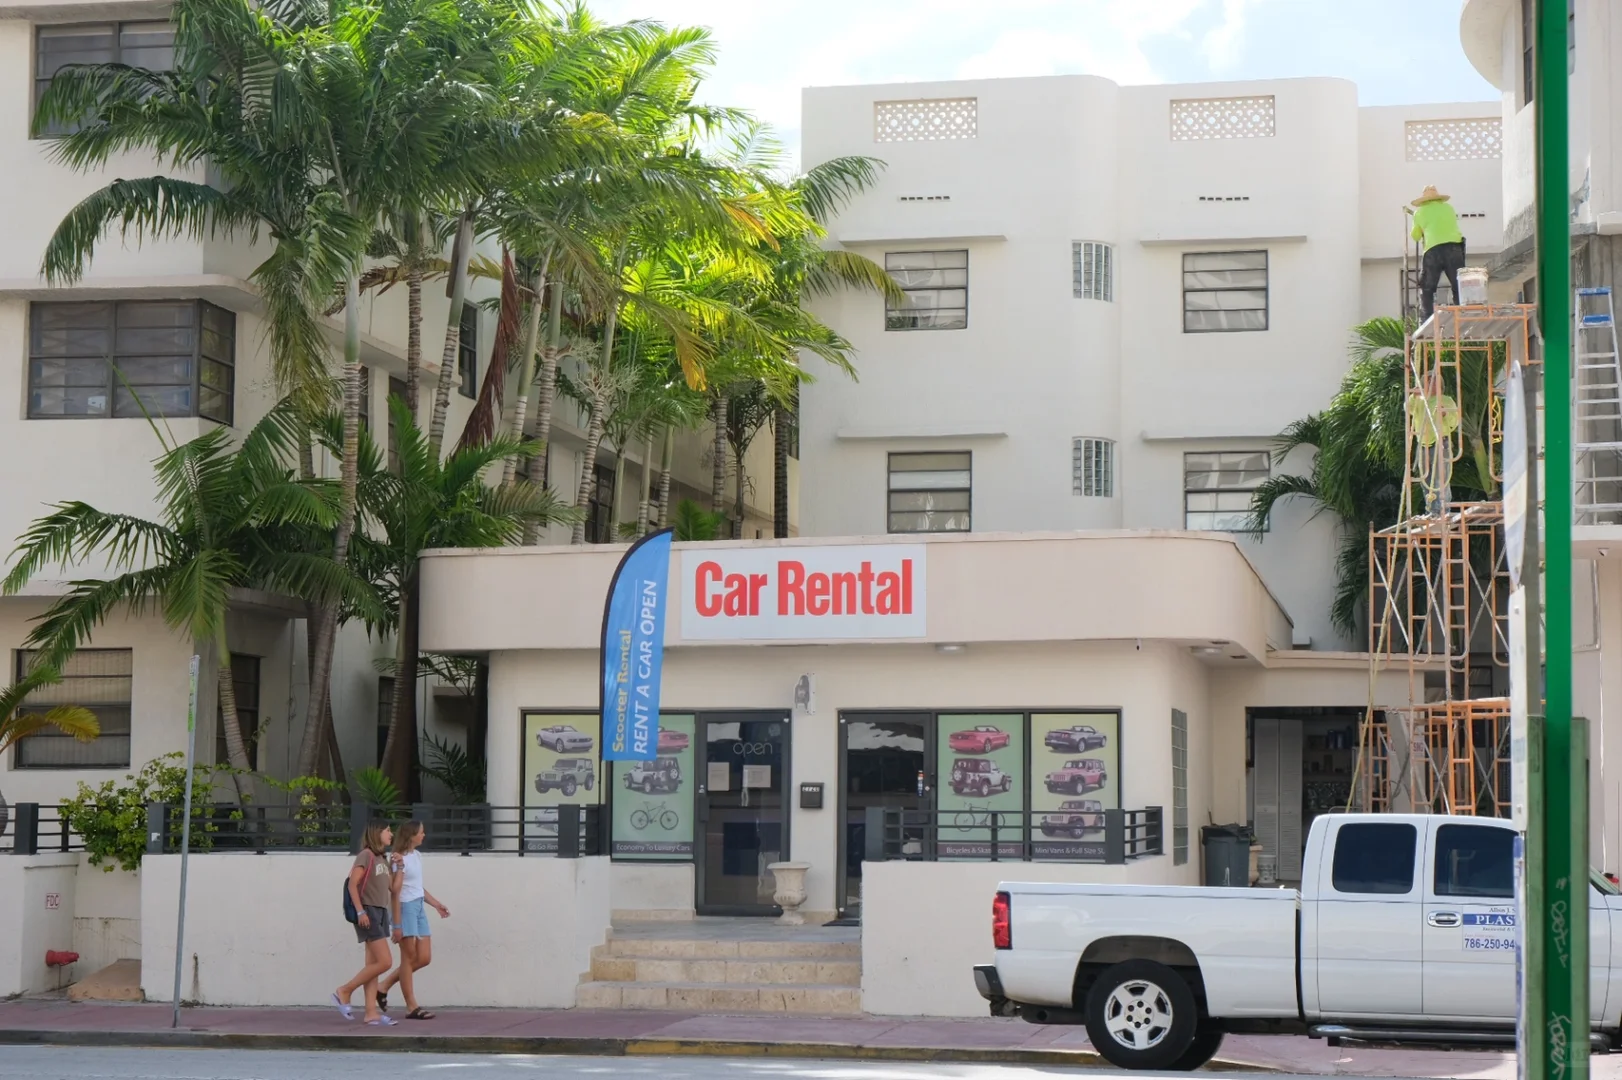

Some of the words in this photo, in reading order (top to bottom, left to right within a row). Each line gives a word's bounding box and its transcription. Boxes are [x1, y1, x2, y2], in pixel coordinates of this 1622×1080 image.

[695, 560, 767, 617] Car
[777, 559, 912, 616] Rental
[640, 580, 657, 635] OPEN
[617, 629, 631, 683] Rental
[638, 640, 653, 680] CAR
[636, 685, 650, 698] A
[612, 688, 628, 752] Scooter
[634, 700, 649, 754] RENT
[733, 742, 773, 758] open
[616, 843, 645, 852] Economy
[646, 843, 654, 851] To
[654, 843, 676, 852] Luxury
[946, 846, 970, 855] Bicycles
[46, 895, 60, 906] FDC
[1475, 915, 1515, 926] PLAS
[1465, 938, 1515, 949] 786-250-94
